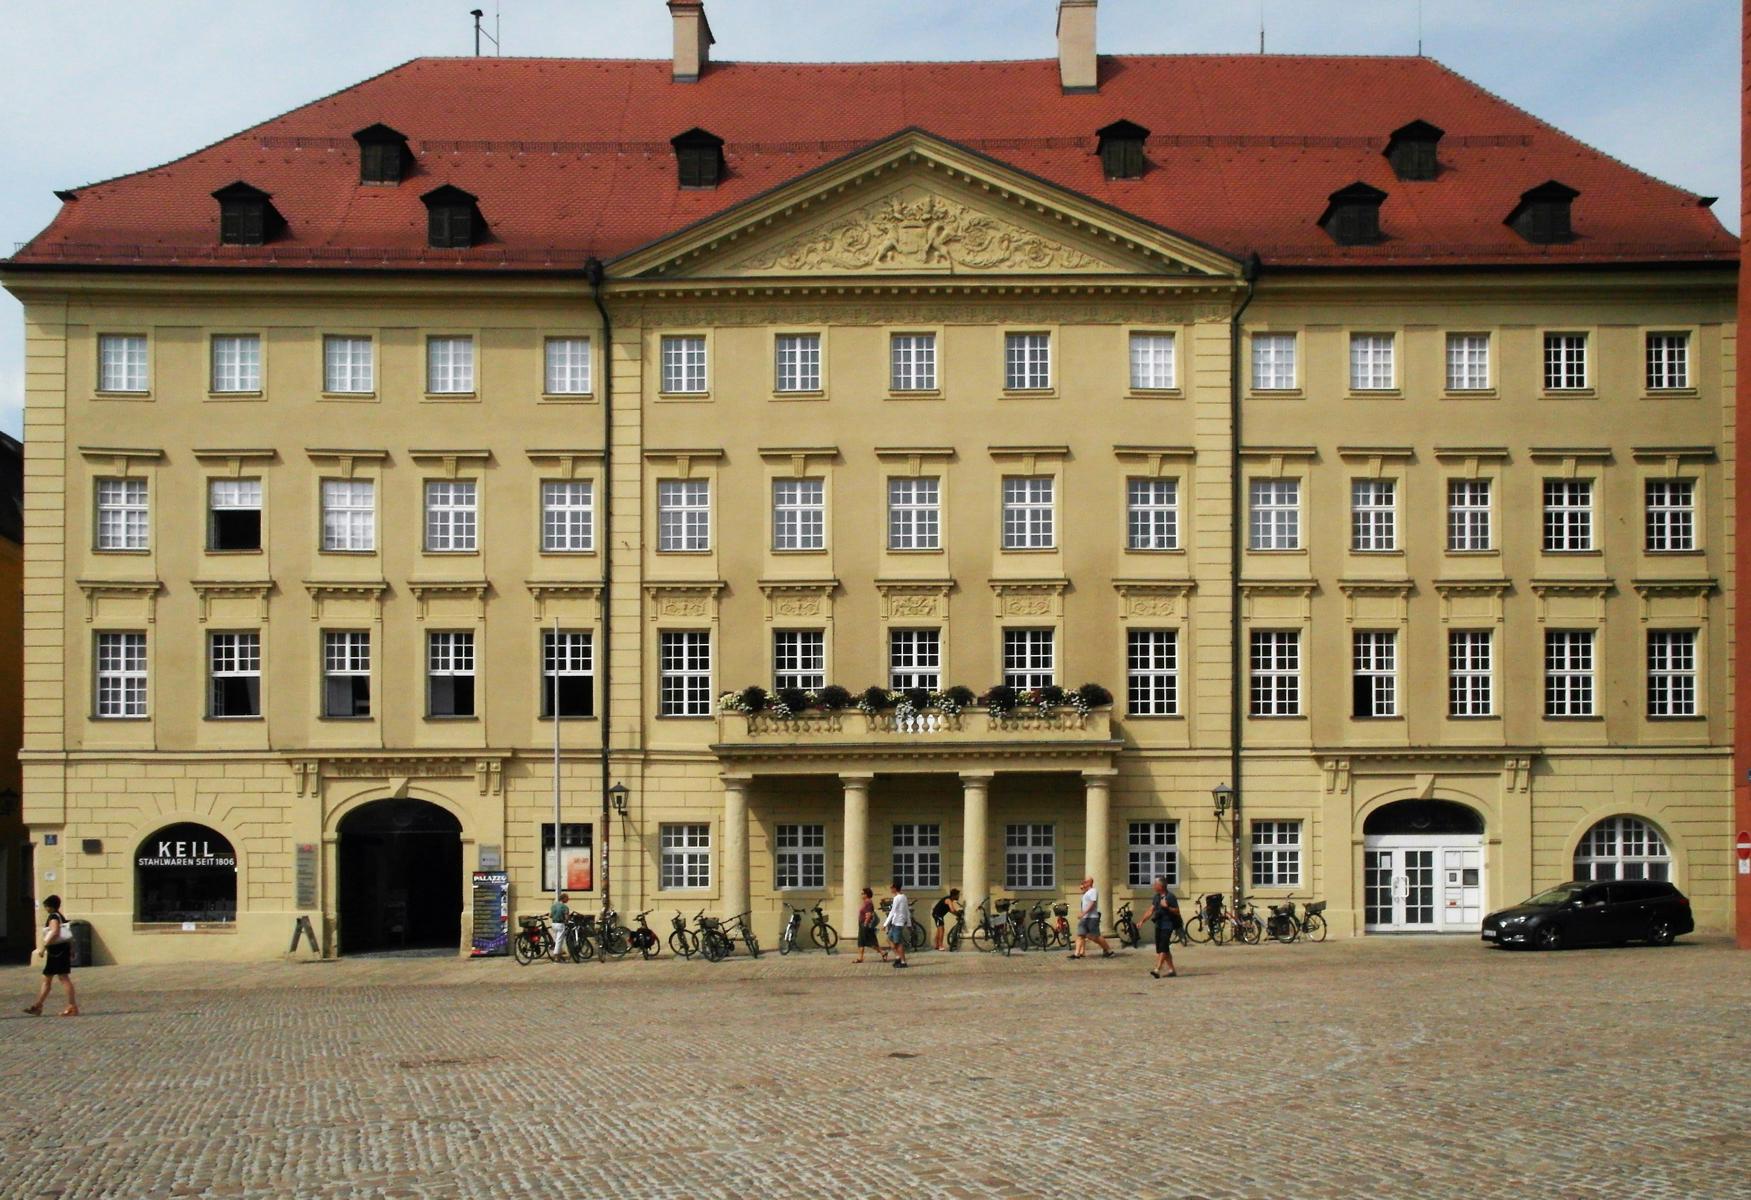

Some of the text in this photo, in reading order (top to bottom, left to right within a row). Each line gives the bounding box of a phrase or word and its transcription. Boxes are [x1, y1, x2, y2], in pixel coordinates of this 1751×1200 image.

[158, 841, 214, 857] KEIL
[138, 858, 234, 866] STAHLWAREN SEIT 1806
